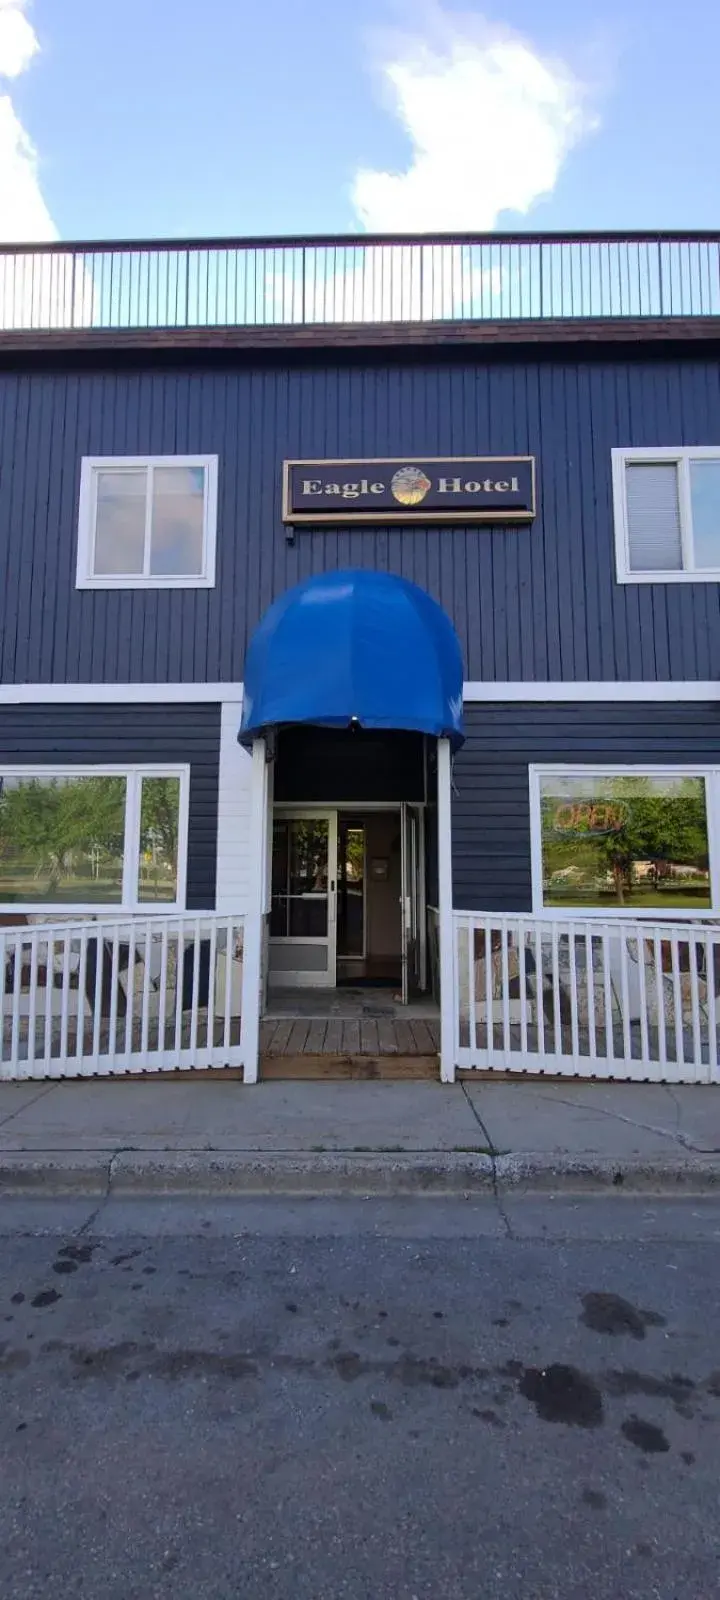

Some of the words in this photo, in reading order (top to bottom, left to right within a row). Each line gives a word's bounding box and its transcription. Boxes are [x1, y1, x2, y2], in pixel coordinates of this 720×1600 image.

[302, 479, 385, 498] Eagle
[437, 477, 520, 493] Hotel
[556, 803, 625, 832] OPEN
